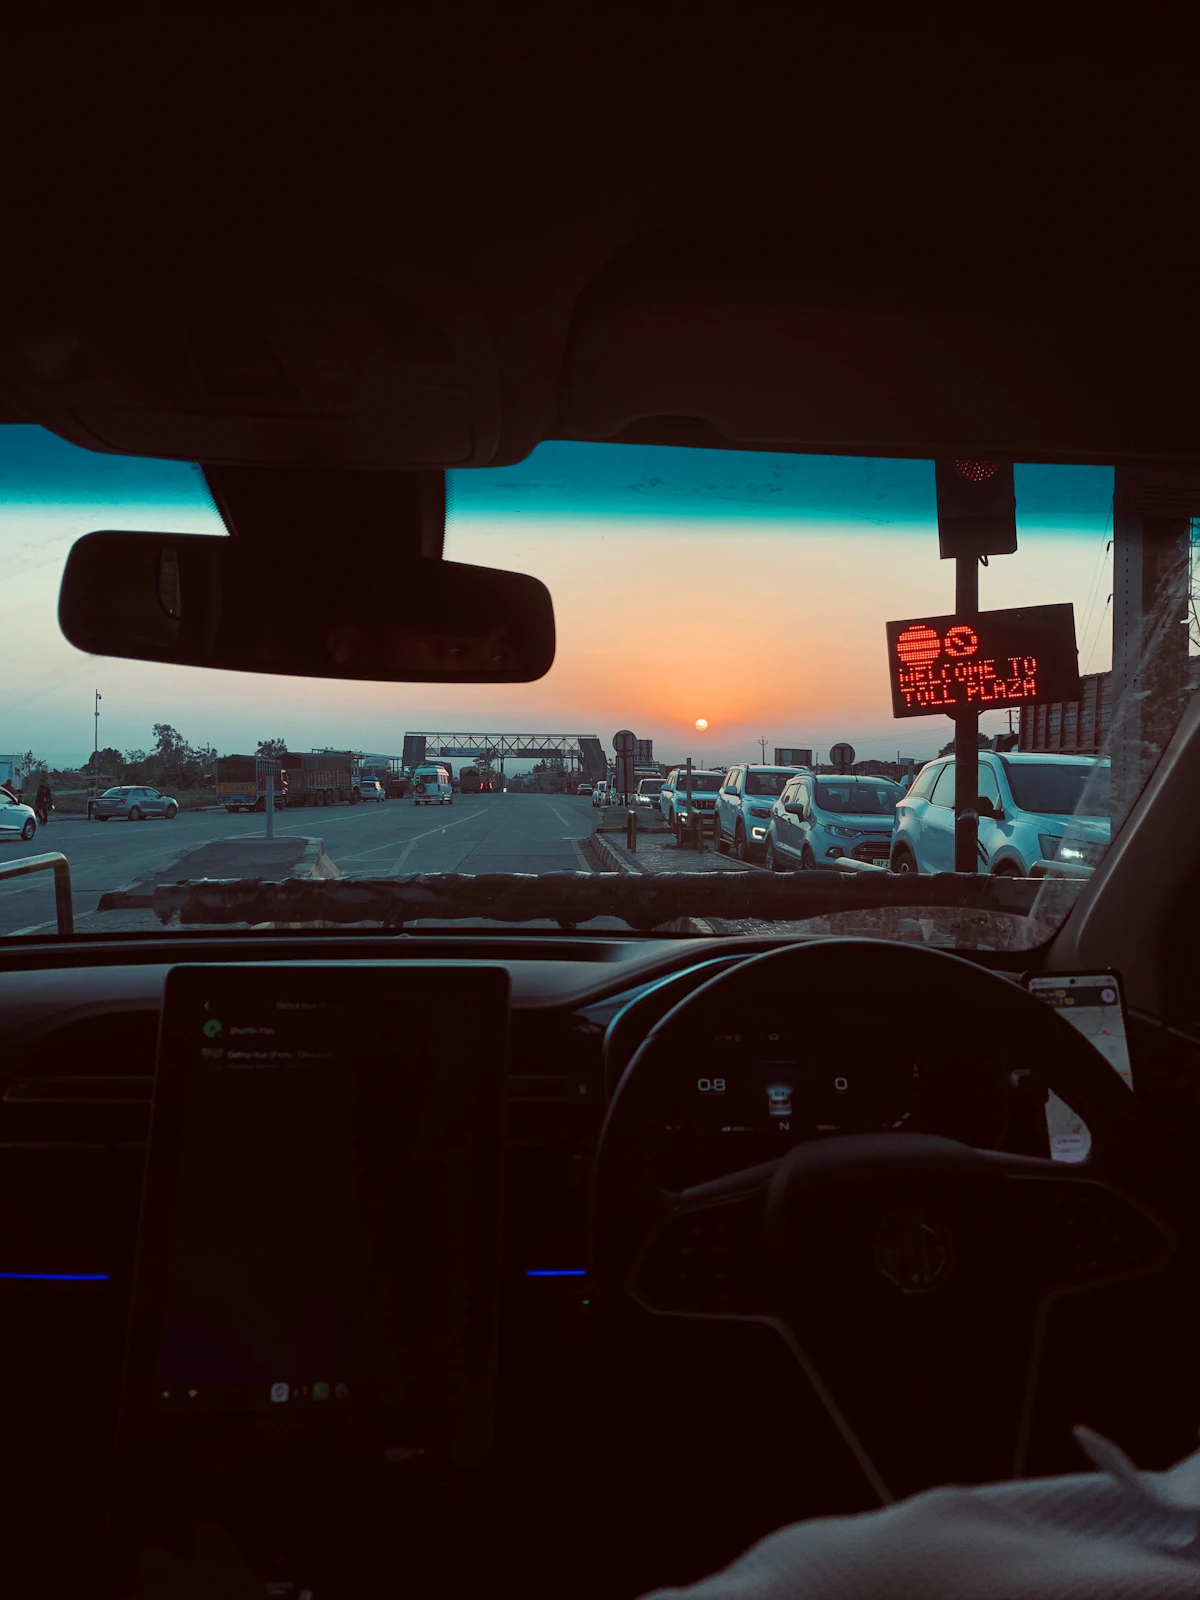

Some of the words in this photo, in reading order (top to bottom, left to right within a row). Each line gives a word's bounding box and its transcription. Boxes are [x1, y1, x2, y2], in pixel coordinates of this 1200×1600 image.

[898, 659, 997, 687] WELCOME
[1007, 656, 1038, 677] TO
[900, 685, 957, 707] TOLL
[967, 677, 1037, 702] PLAZA
[835, 1077, 848, 1090] 0
[778, 1121, 791, 1132] N
